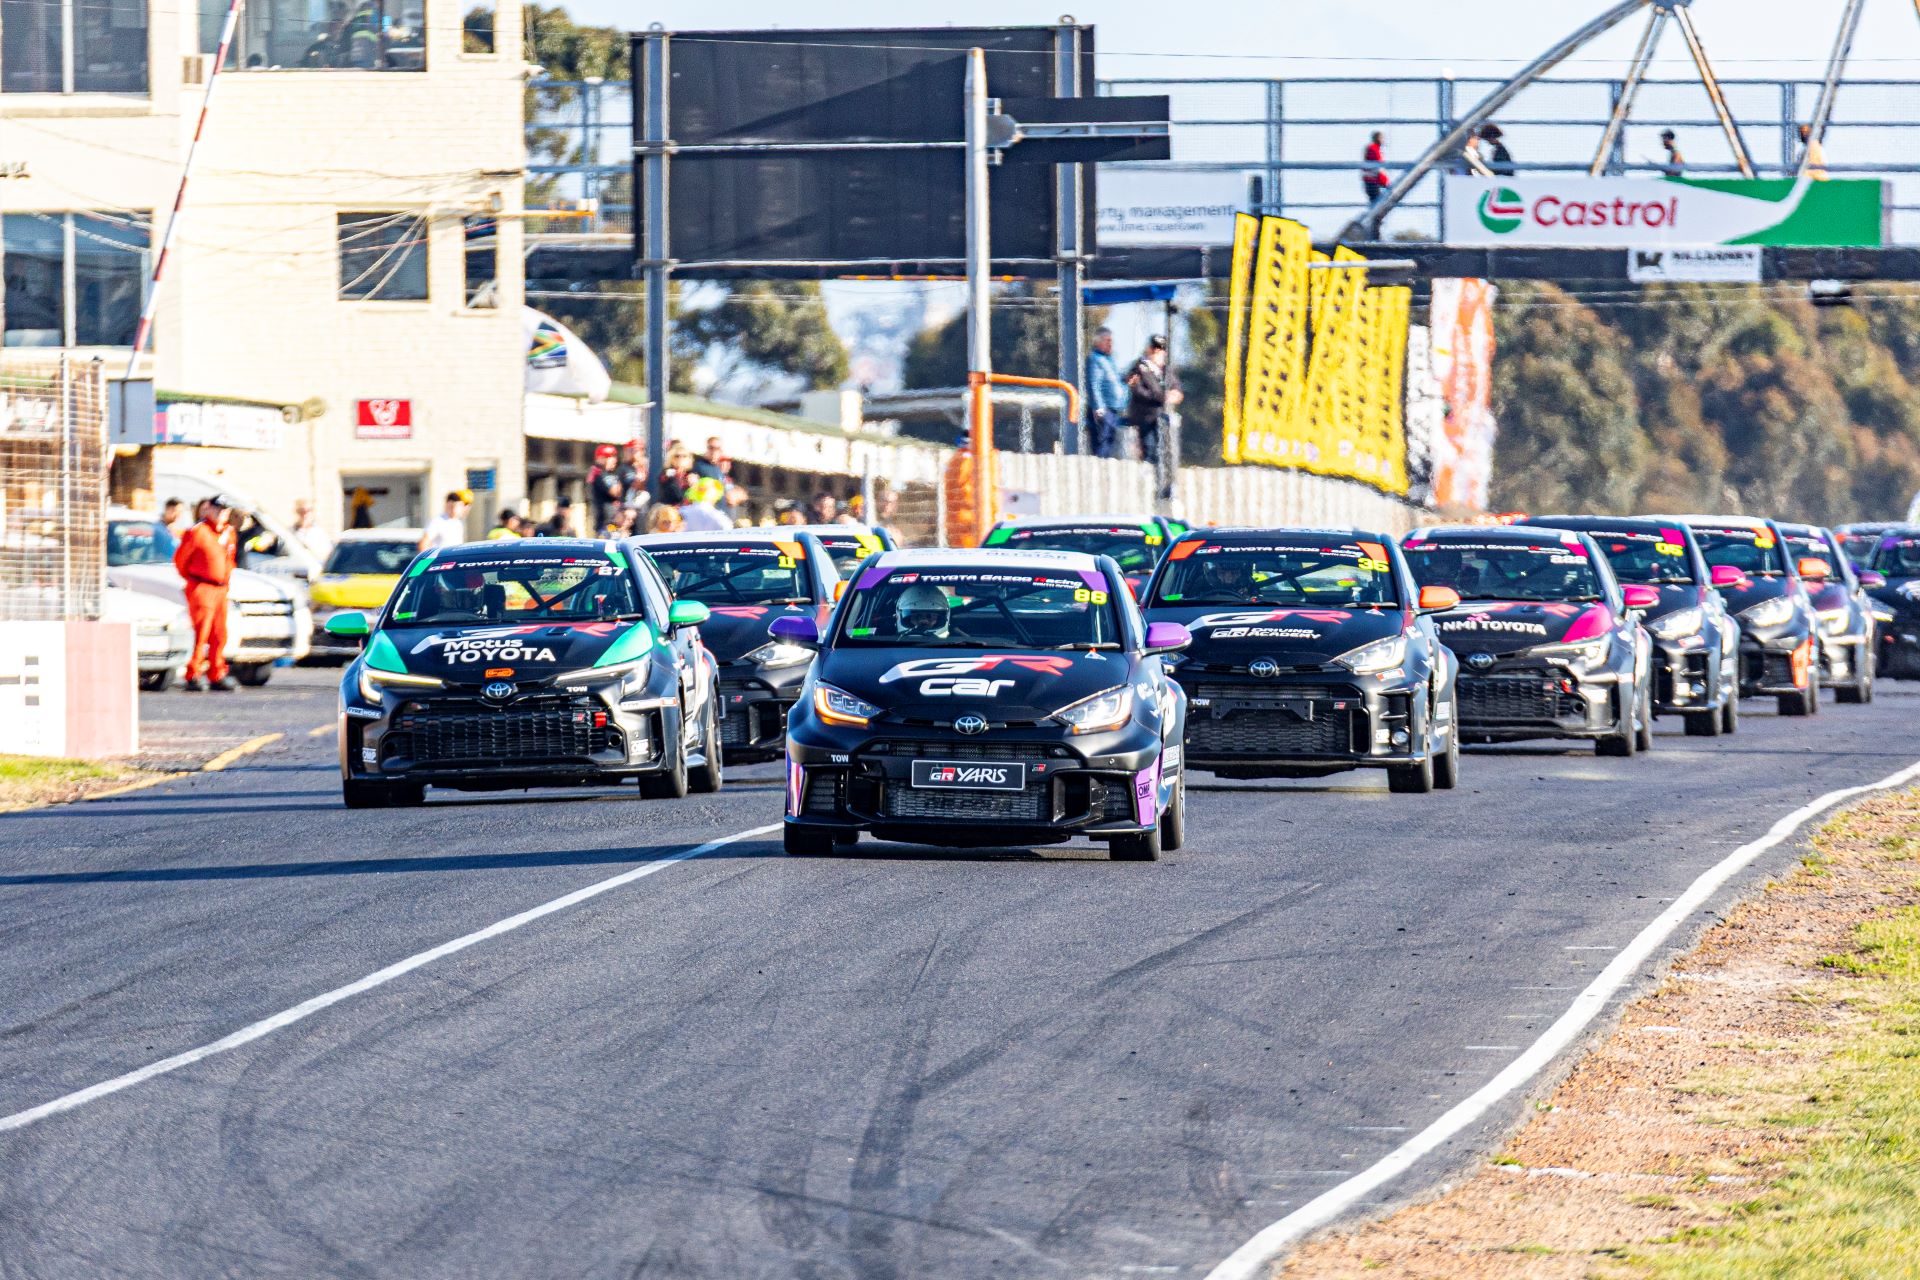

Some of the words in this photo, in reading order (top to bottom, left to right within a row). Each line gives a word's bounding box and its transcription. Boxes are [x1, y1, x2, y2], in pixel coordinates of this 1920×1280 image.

[1533, 196, 1678, 227] Castrol
[458, 560, 511, 568] TOYOTA
[562, 558, 610, 567] Racing
[778, 556, 796, 568] 11
[599, 567, 625, 576] 87
[889, 574, 919, 583] GR
[1033, 577, 1083, 587] Racing
[1074, 588, 1107, 604] 88
[1185, 609, 1353, 632] GR
[1247, 631, 1322, 639] ACADEMY
[1442, 620, 1478, 632] NMI
[1481, 620, 1547, 636] TOYOTA
[444, 639, 523, 652] Motus
[443, 648, 556, 665] TOYOTA
[879, 655, 1073, 683] GR
[919, 678, 1015, 697] car
[831, 754, 849, 762] TOW
[930, 767, 955, 781] GR
